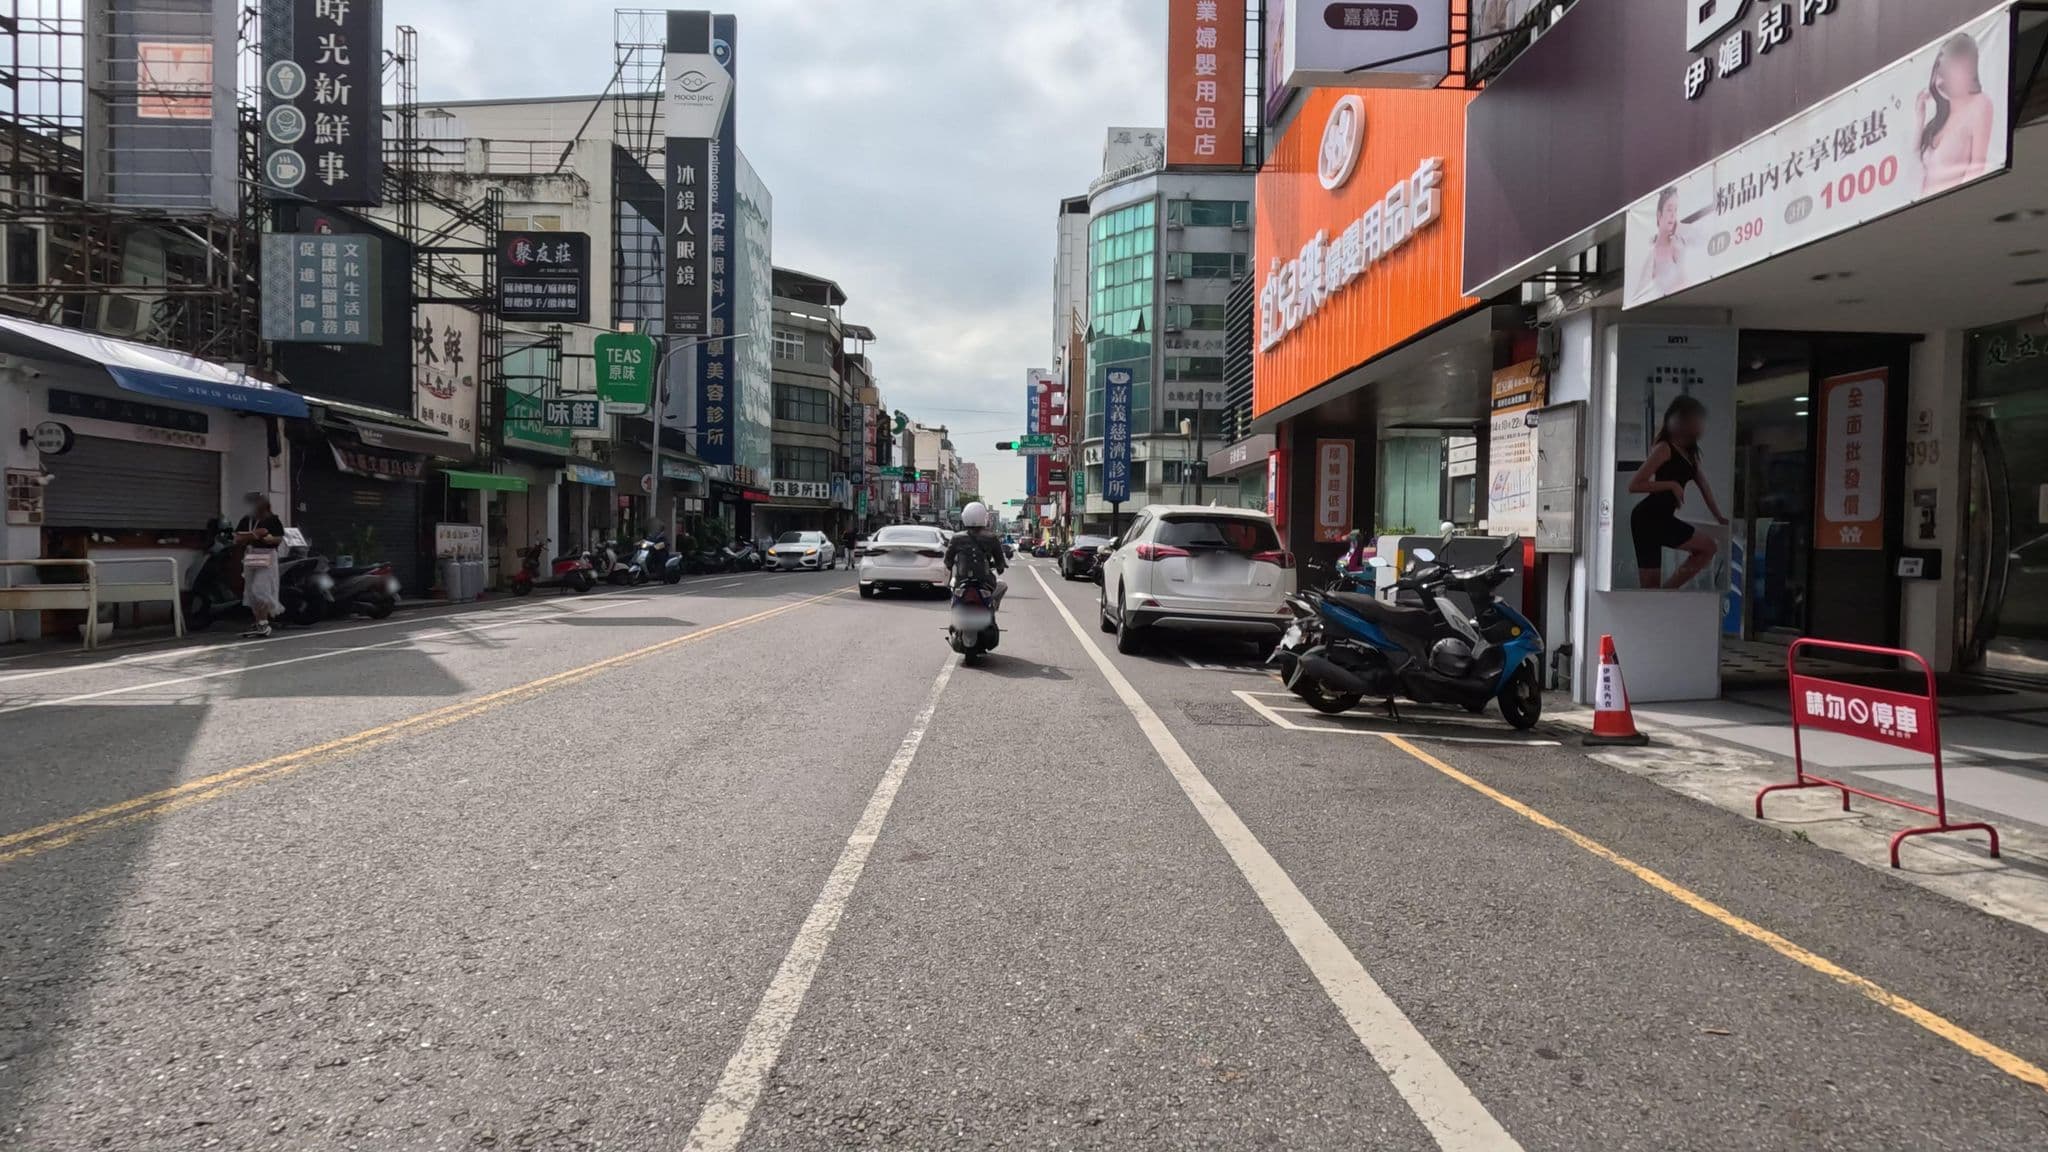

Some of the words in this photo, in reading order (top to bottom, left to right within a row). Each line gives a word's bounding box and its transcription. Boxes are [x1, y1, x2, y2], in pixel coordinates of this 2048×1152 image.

[1343, 7, 1399, 27] 嘉義店
[1715, 107, 1888, 215] 精品內衣享優惠
[1820, 155, 1898, 210] 1000
[515, 241, 572, 264] 聚友莊
[1734, 216, 1764, 247] 390
[299, 242, 316, 334] 促進協會
[343, 243, 360, 335] 文化生活與
[608, 365, 636, 381] 原味
[547, 402, 595, 426] 味鮮
[1107, 385, 1128, 497] 嘉義慈濟診所
[1805, 690, 1847, 722] 請勿
[1871, 701, 1919, 733] 停車
